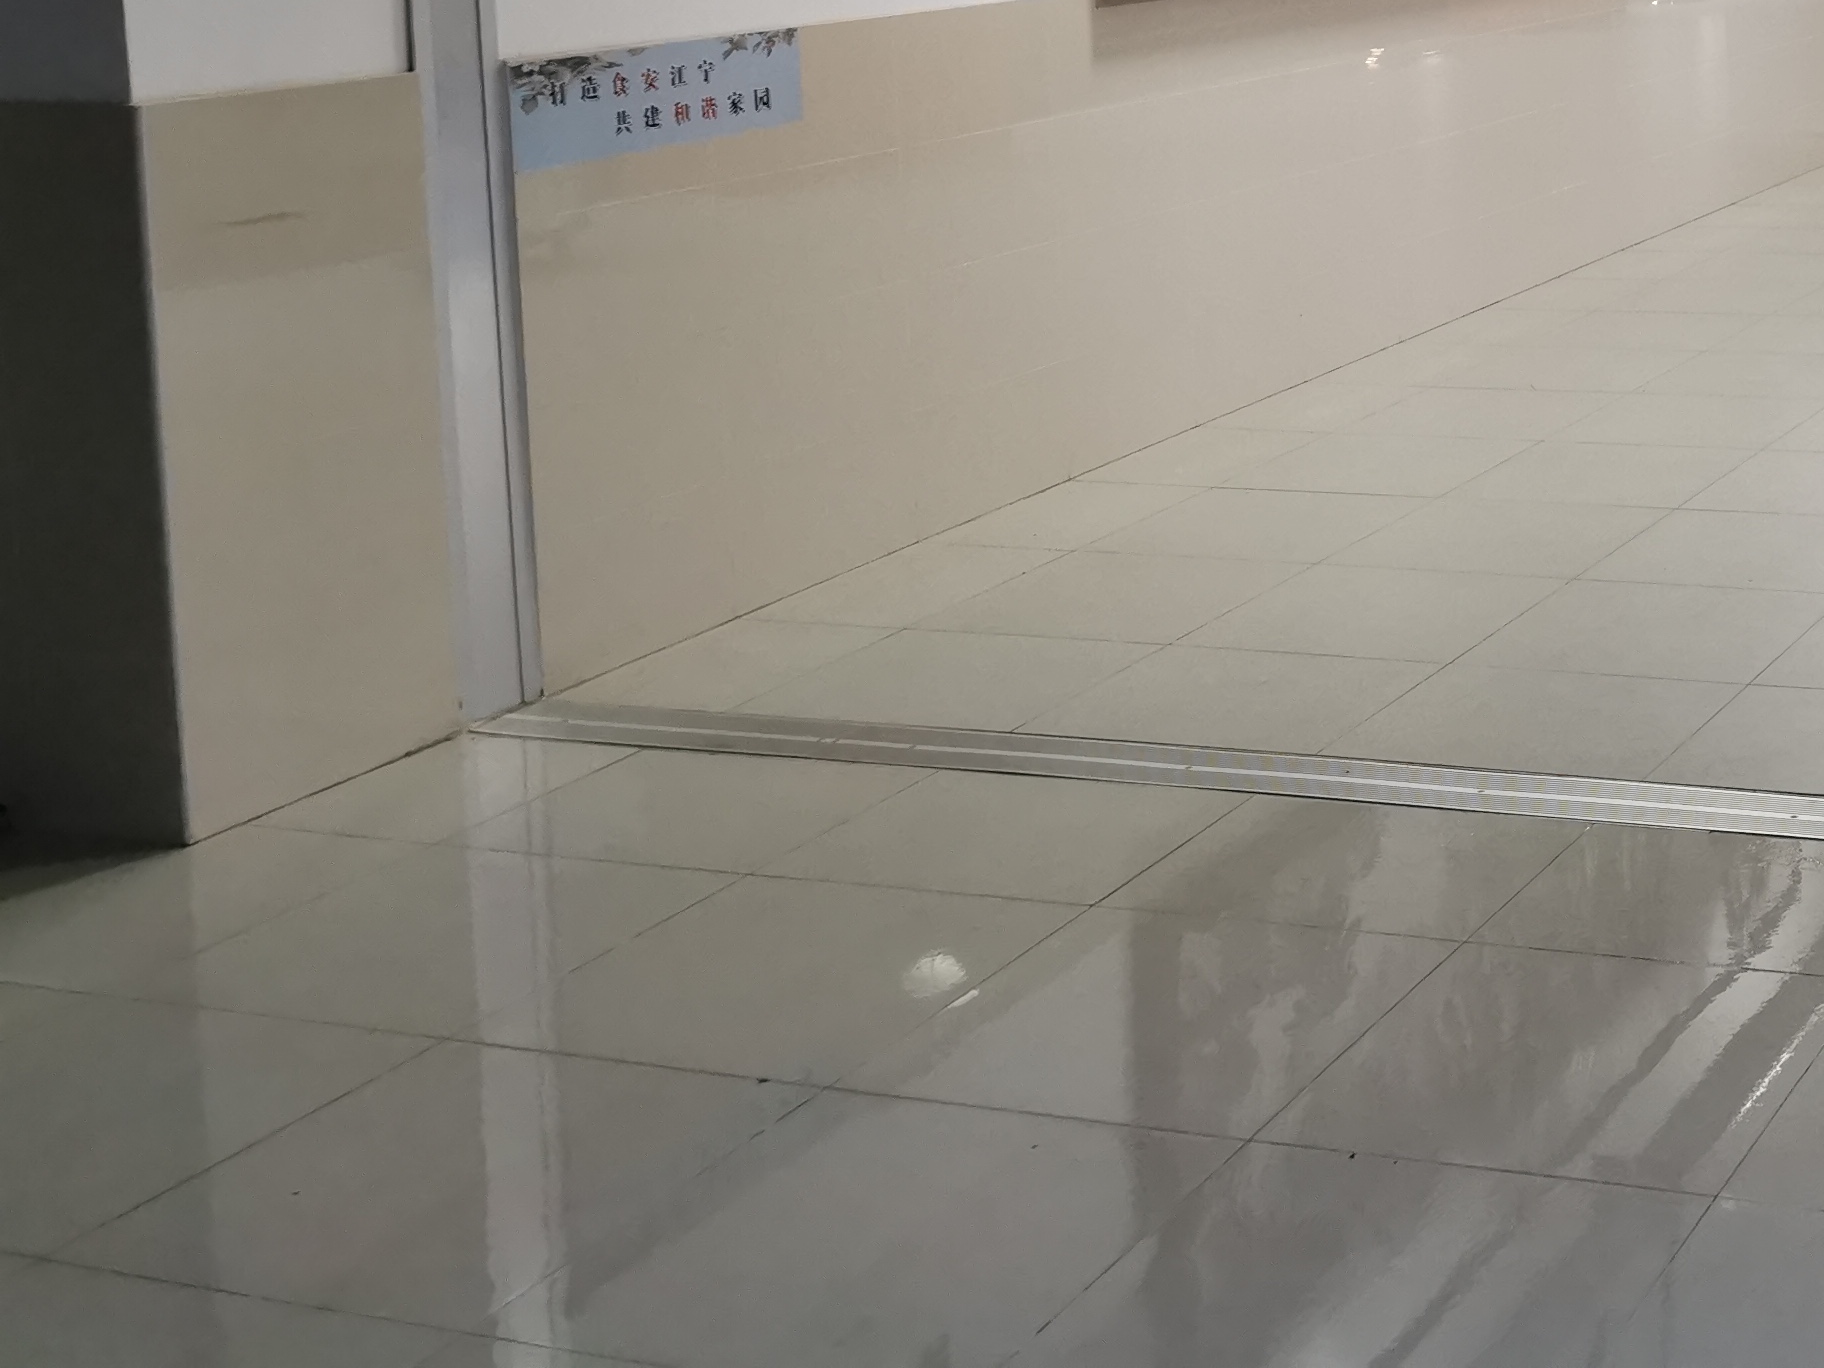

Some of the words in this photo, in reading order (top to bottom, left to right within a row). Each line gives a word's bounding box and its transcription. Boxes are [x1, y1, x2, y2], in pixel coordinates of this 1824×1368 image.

[549, 59, 716, 106] 打造食安江宁
[614, 86, 773, 136] 共建和谐家园
